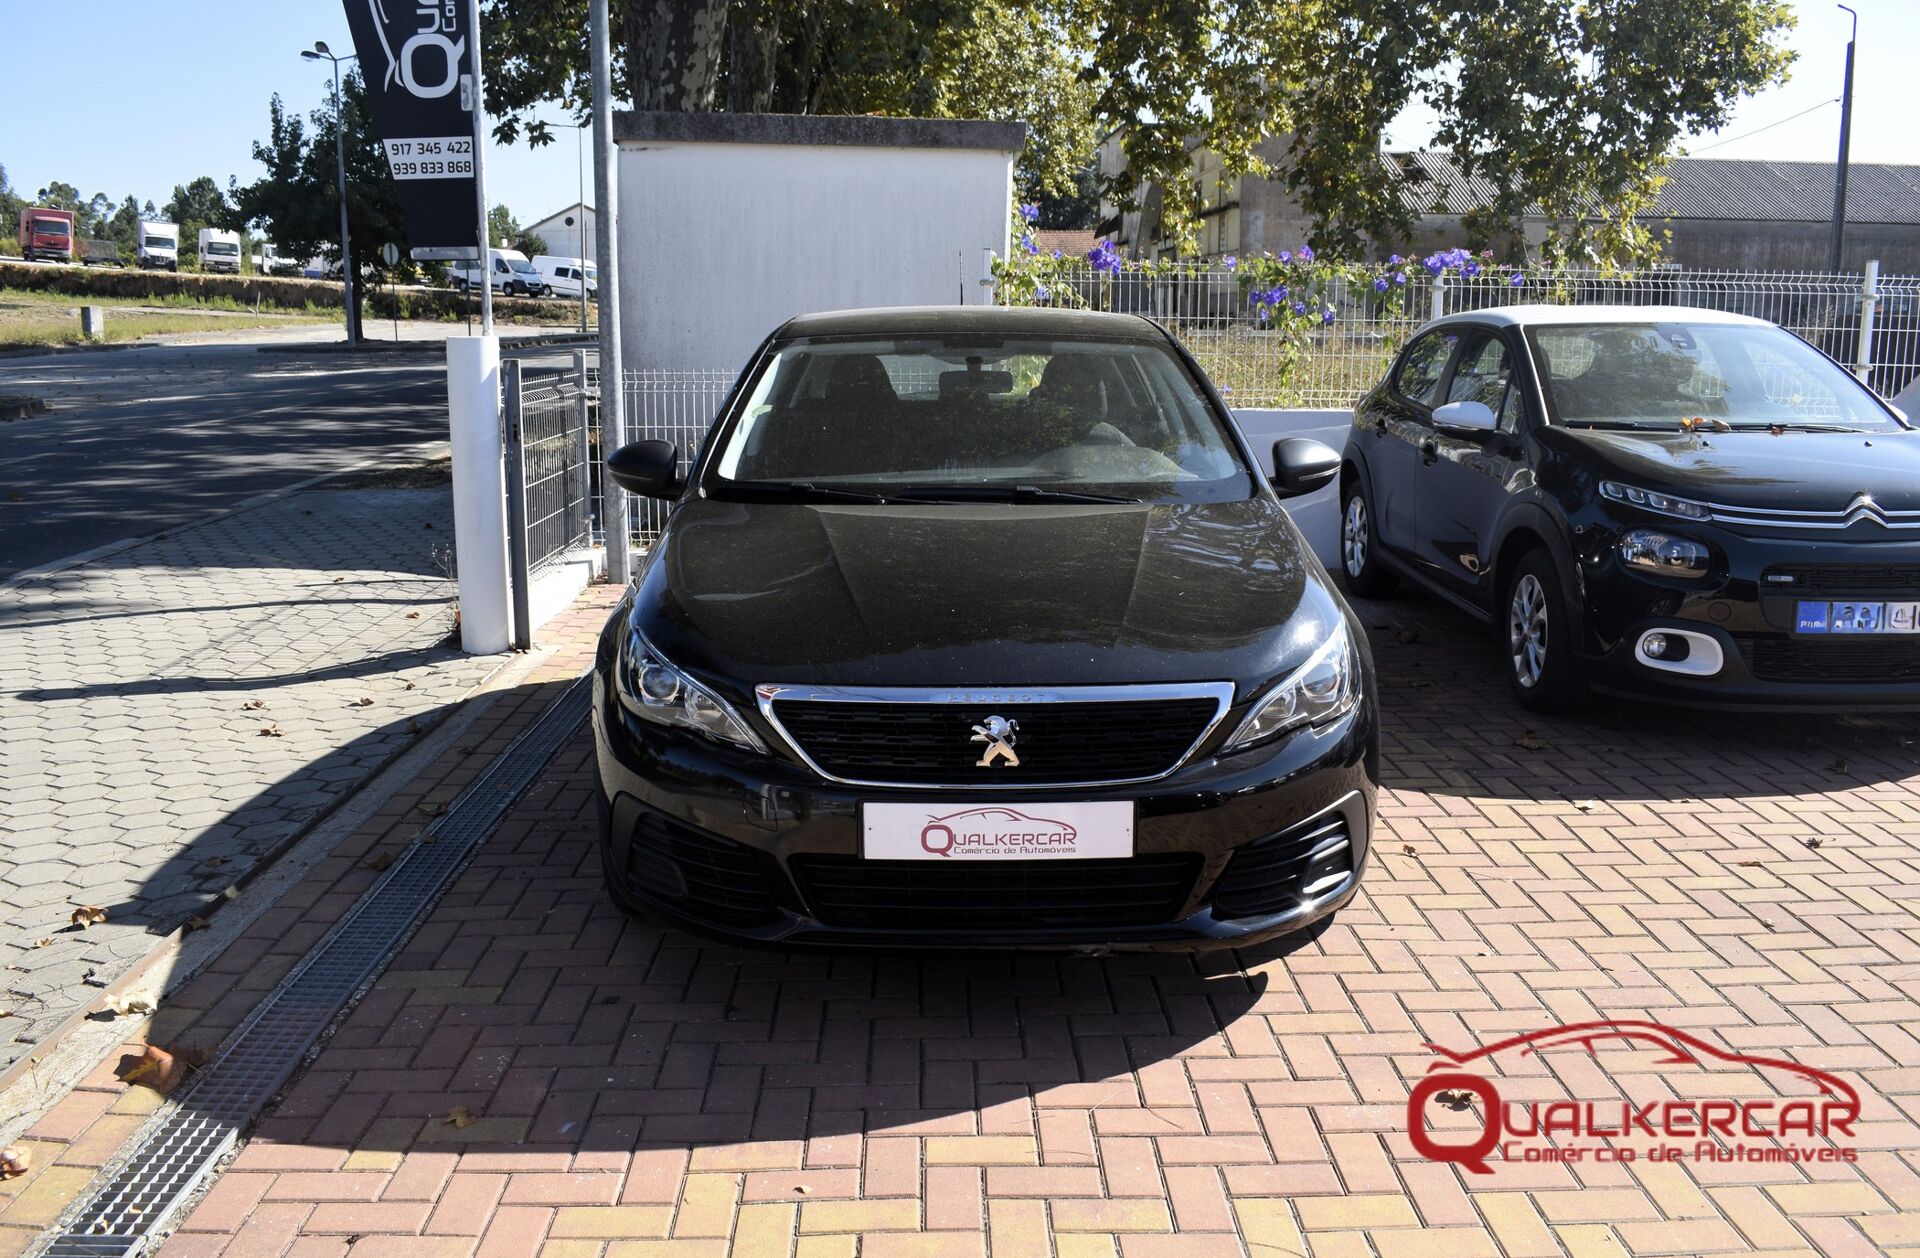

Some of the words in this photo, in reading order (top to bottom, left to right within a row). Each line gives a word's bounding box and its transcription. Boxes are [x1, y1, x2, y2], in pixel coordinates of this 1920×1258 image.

[442, 0, 457, 32] Co
[401, 0, 465, 99] QU
[391, 143, 412, 156] 917
[417, 142, 442, 155] 345
[447, 141, 471, 154] 422
[393, 162, 417, 175] 939
[421, 161, 444, 174] 833
[447, 160, 471, 173] 868
[921, 824, 1077, 857] QUALKERCAR
[953, 845, 1000, 854] Comércio
[1003, 846, 1017, 854] de
[1020, 845, 1076, 854] Automóveis
